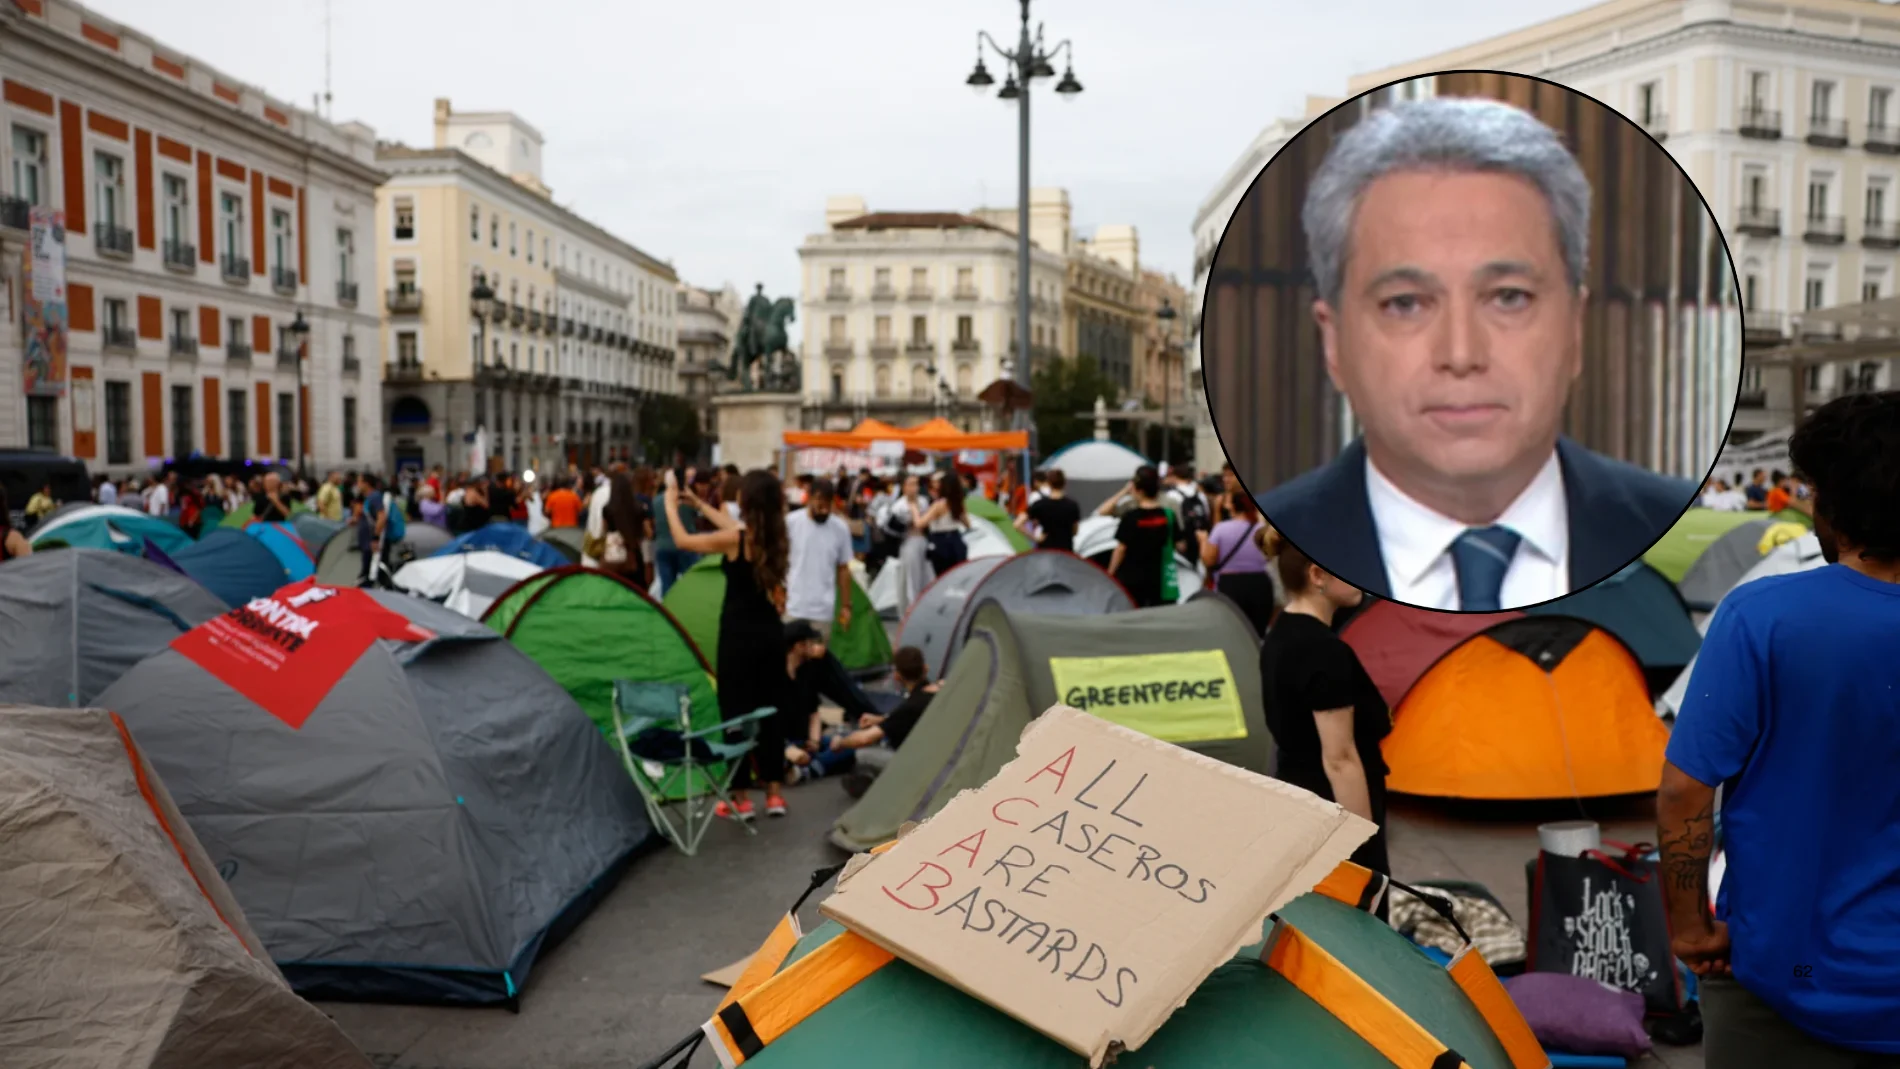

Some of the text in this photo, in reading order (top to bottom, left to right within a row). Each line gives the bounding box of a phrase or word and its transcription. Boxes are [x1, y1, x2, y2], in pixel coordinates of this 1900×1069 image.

[1065, 678, 1226, 711] GREENPEACE
[1025, 746, 1149, 828] ALL
[938, 829, 1071, 898] ARE
[992, 797, 1217, 904] CASEROS
[881, 861, 1139, 1008] BASTARDS
